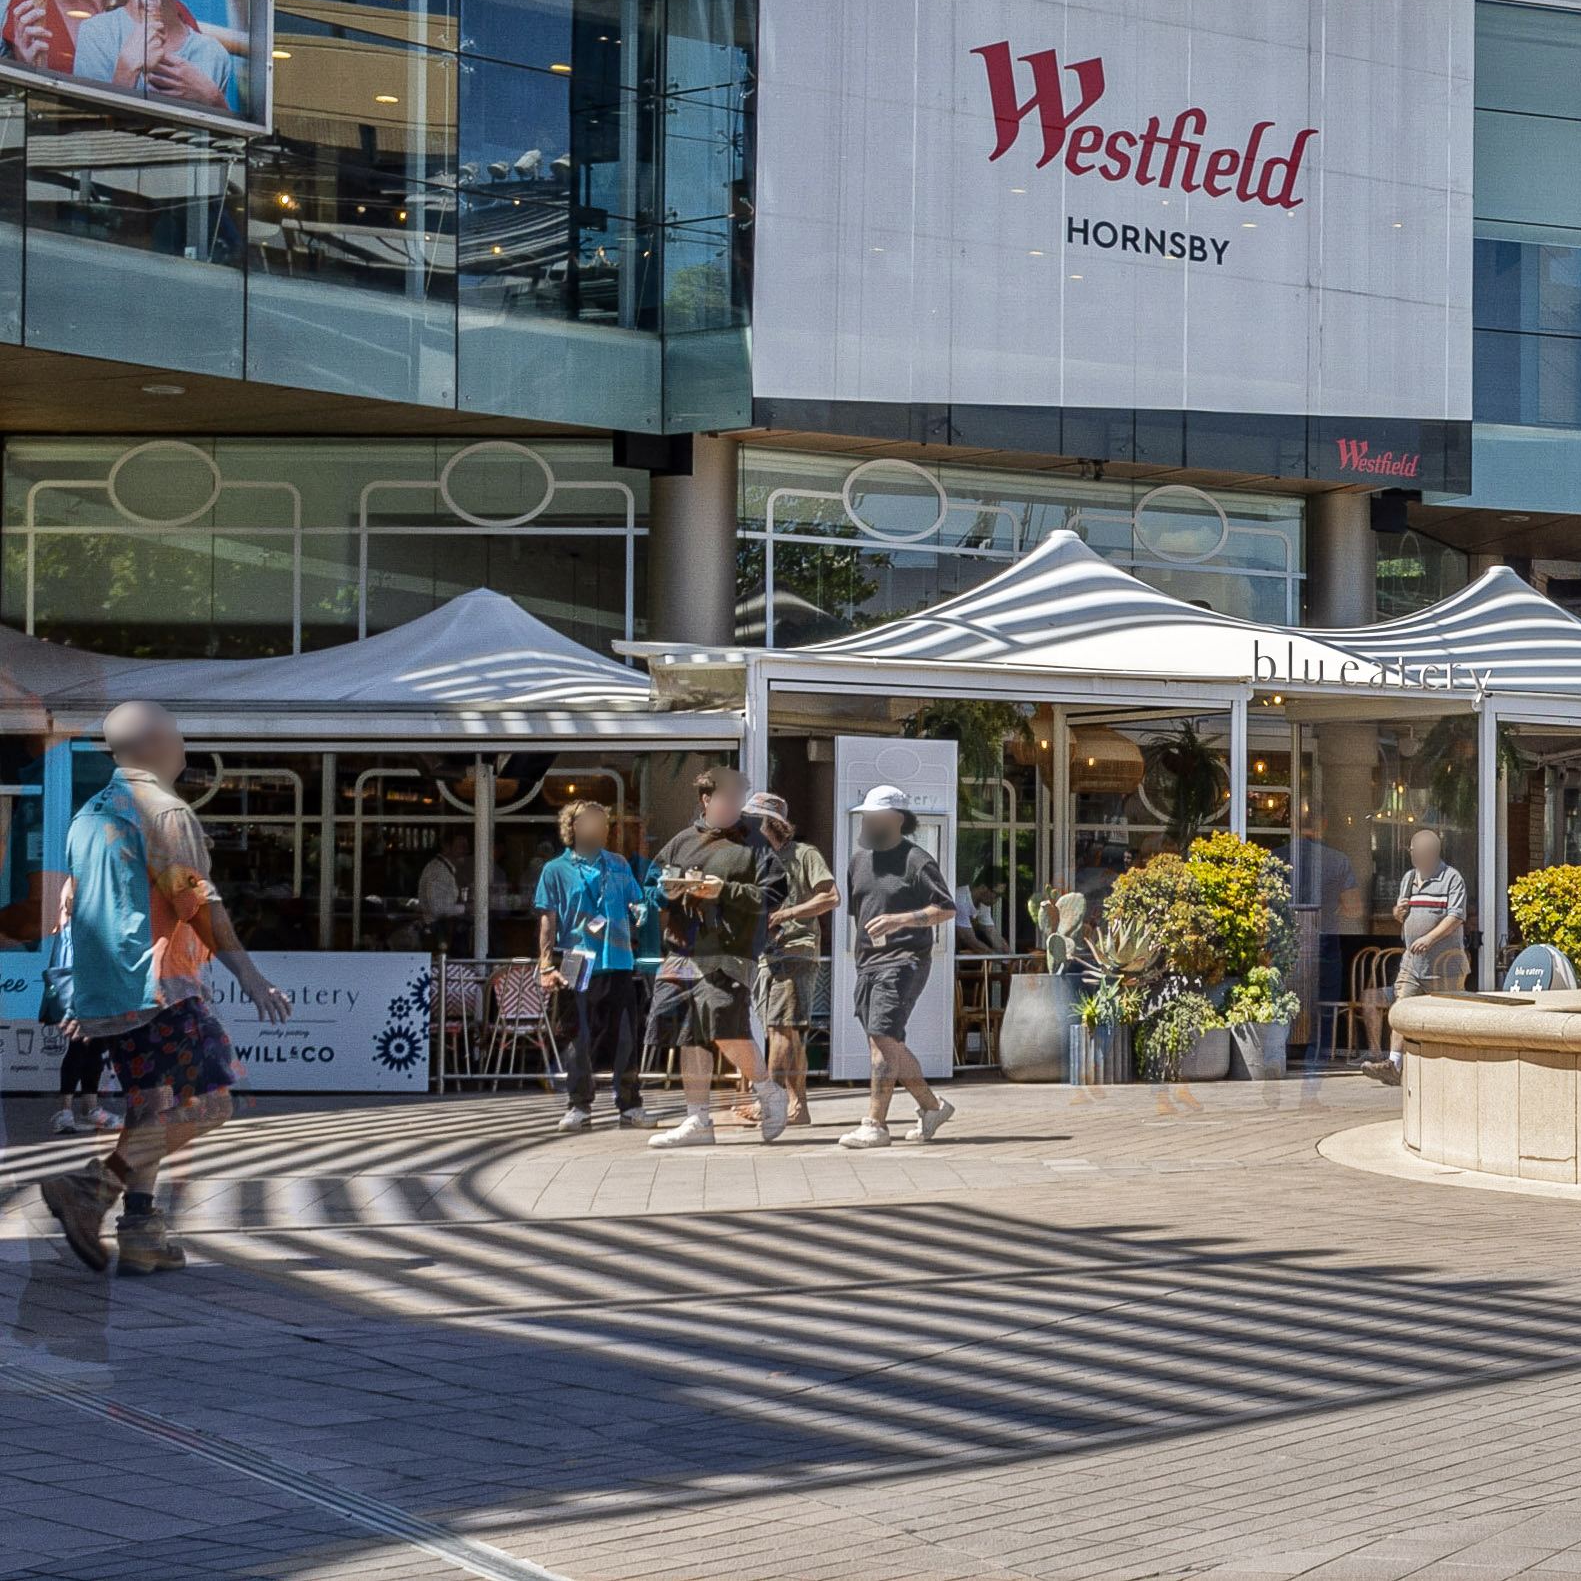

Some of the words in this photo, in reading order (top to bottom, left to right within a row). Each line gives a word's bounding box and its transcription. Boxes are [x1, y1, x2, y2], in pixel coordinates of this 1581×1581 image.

[970, 41, 1319, 209] Westfield
[1067, 216, 1230, 265] HORNSBY
[1336, 438, 1419, 477] Westfield
[282, 985, 360, 1012] atery
